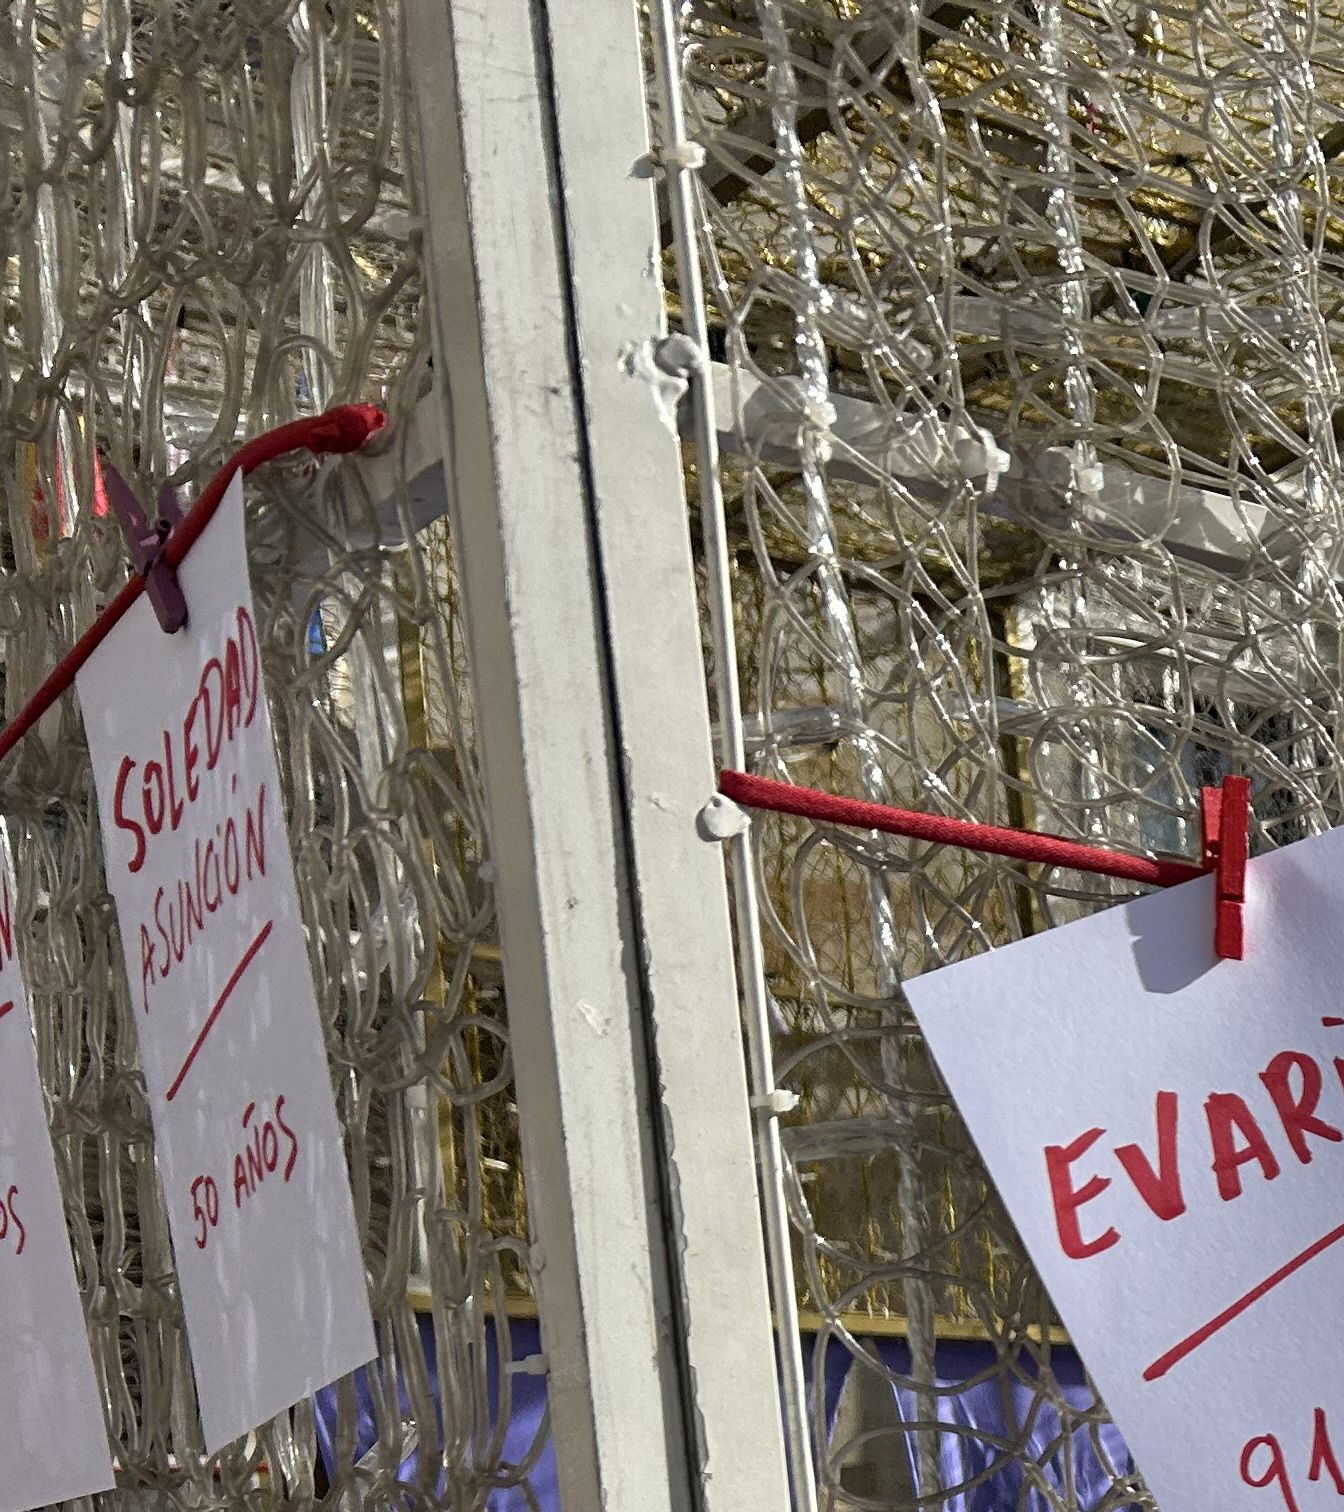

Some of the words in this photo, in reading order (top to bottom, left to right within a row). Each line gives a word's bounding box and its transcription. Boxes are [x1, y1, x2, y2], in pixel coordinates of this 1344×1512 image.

[113, 605, 260, 874] SOLEDAD
[190, 1174, 219, 1250] 50
[233, 1094, 298, 1209] AÑOS
